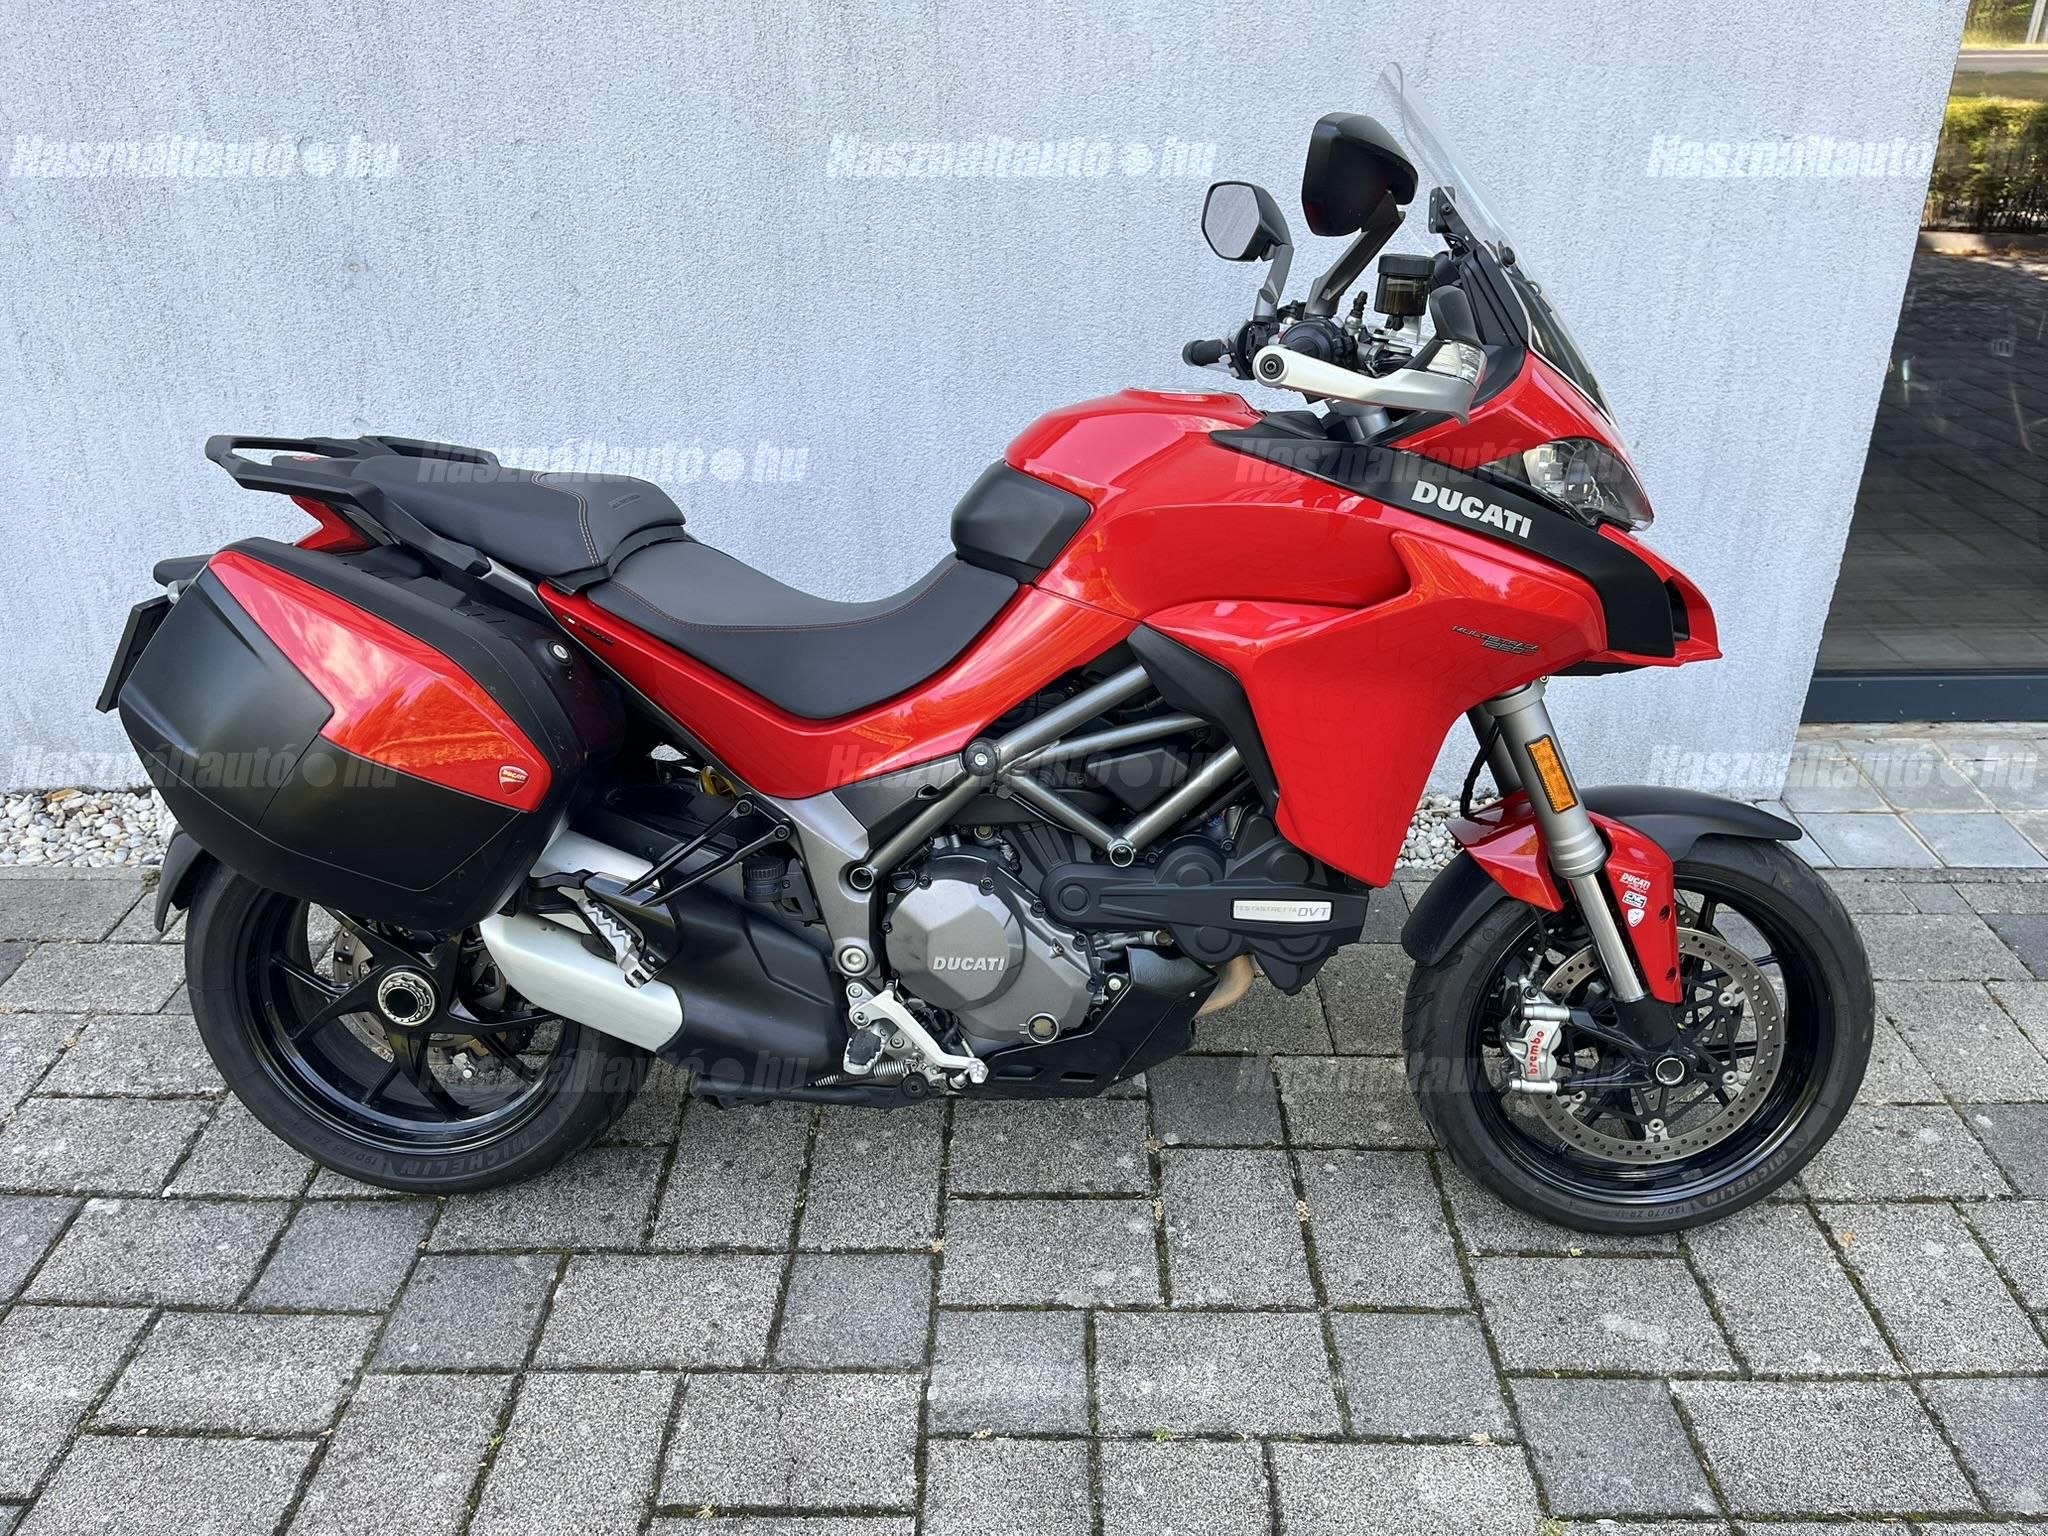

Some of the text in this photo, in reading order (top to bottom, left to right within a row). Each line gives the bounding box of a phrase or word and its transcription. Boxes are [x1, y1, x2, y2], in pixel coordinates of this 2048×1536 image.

[1411, 480, 1533, 539] DUCATI
[502, 769, 527, 781] DUCATI
[1621, 872, 1651, 890] DUCATI
[1297, 907, 1329, 917] DVT
[933, 956, 1005, 971] DUCATI
[1527, 1030, 1545, 1076] brembo
[400, 1135, 531, 1175] MICHELIN
[1706, 1150, 1789, 1206] MICHELIN
[1647, 1206, 1685, 1218] 120/70
